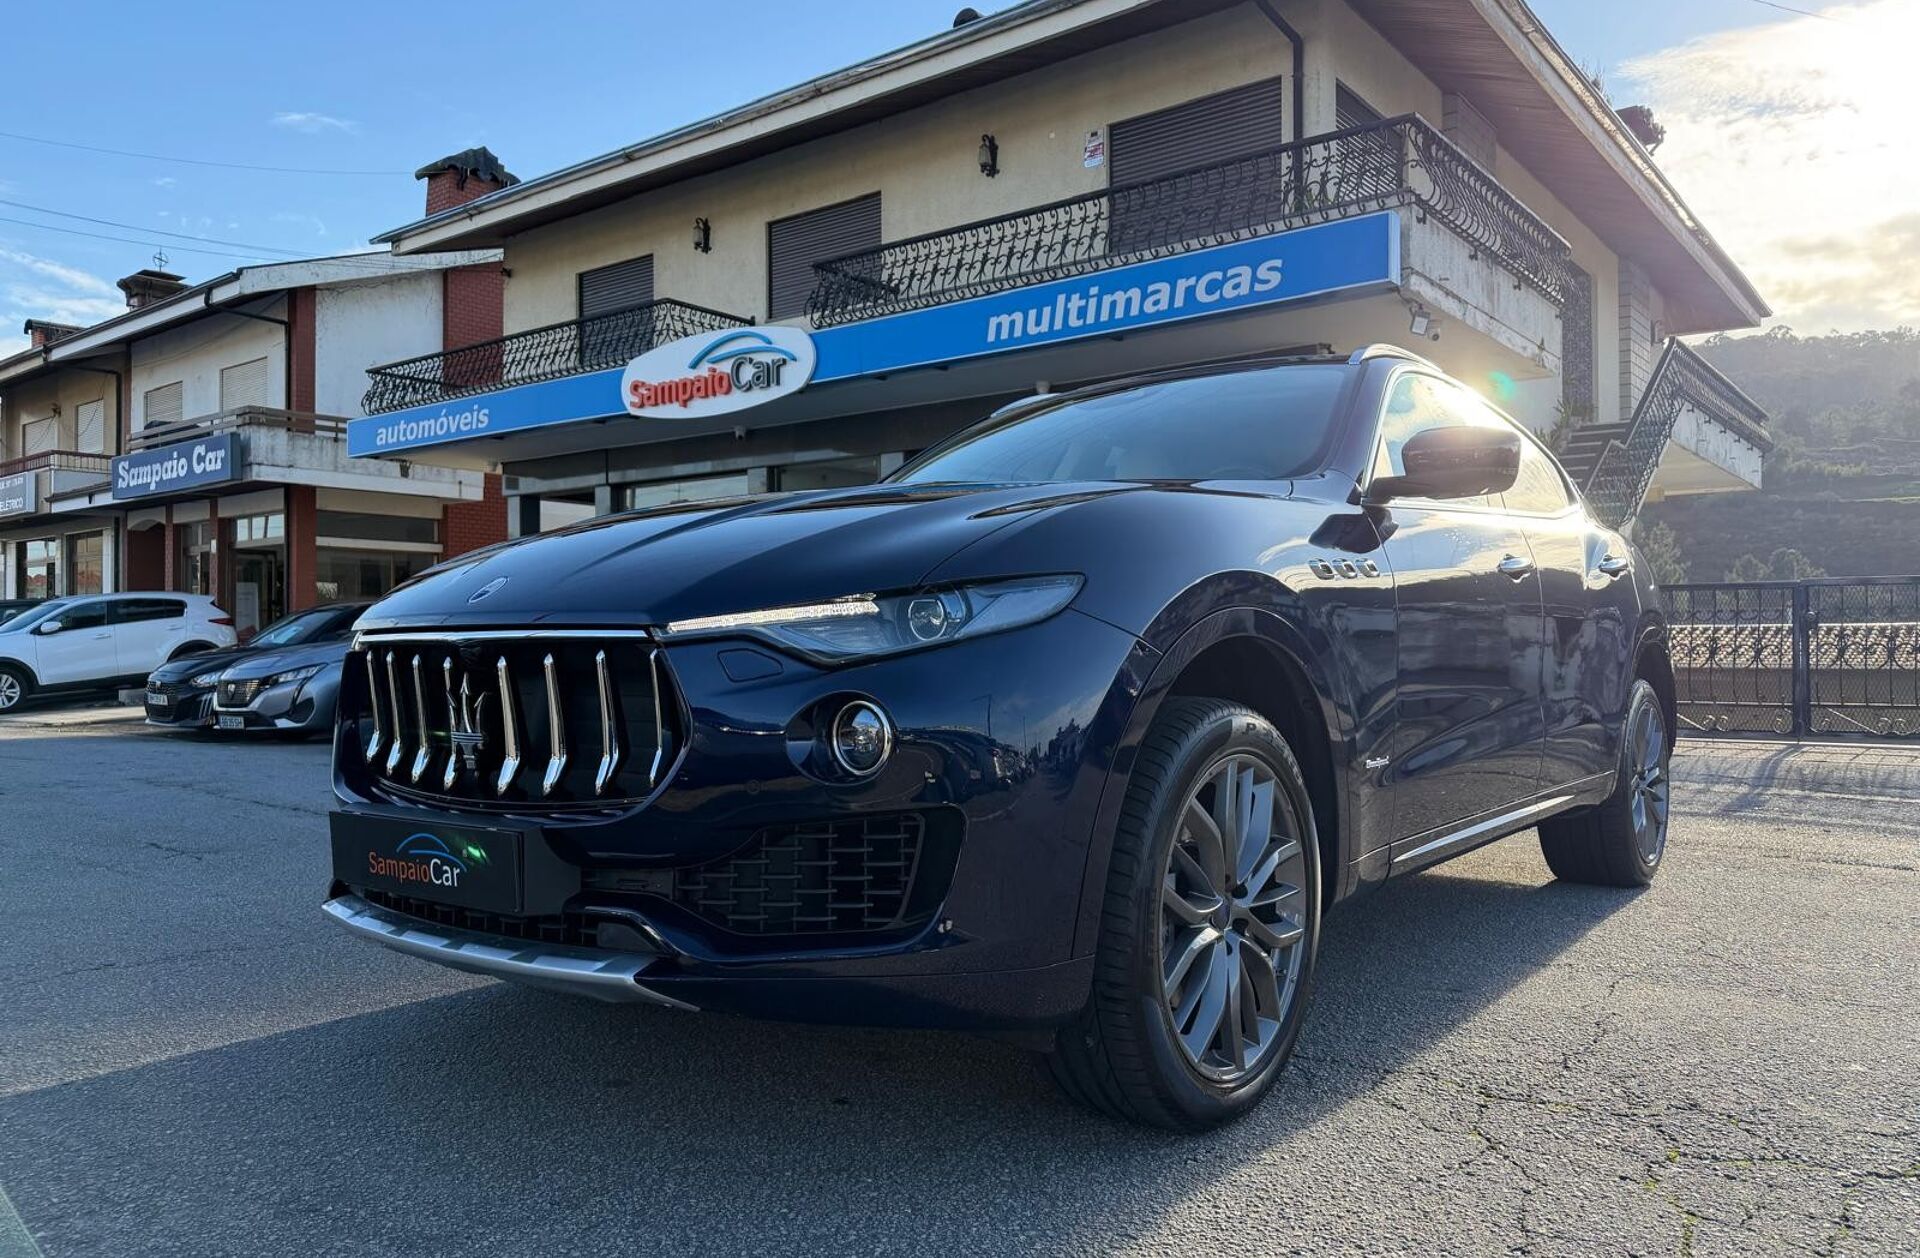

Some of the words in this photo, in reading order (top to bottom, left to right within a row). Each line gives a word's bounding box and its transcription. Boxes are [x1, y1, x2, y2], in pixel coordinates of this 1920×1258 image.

[986, 258, 1284, 343] multimarcas
[629, 355, 788, 409] SampaioCar
[376, 403, 490, 446] automóveis
[117, 450, 188, 491] Sampaio
[192, 443, 225, 475] Car
[368, 851, 461, 887] SampaioCar
